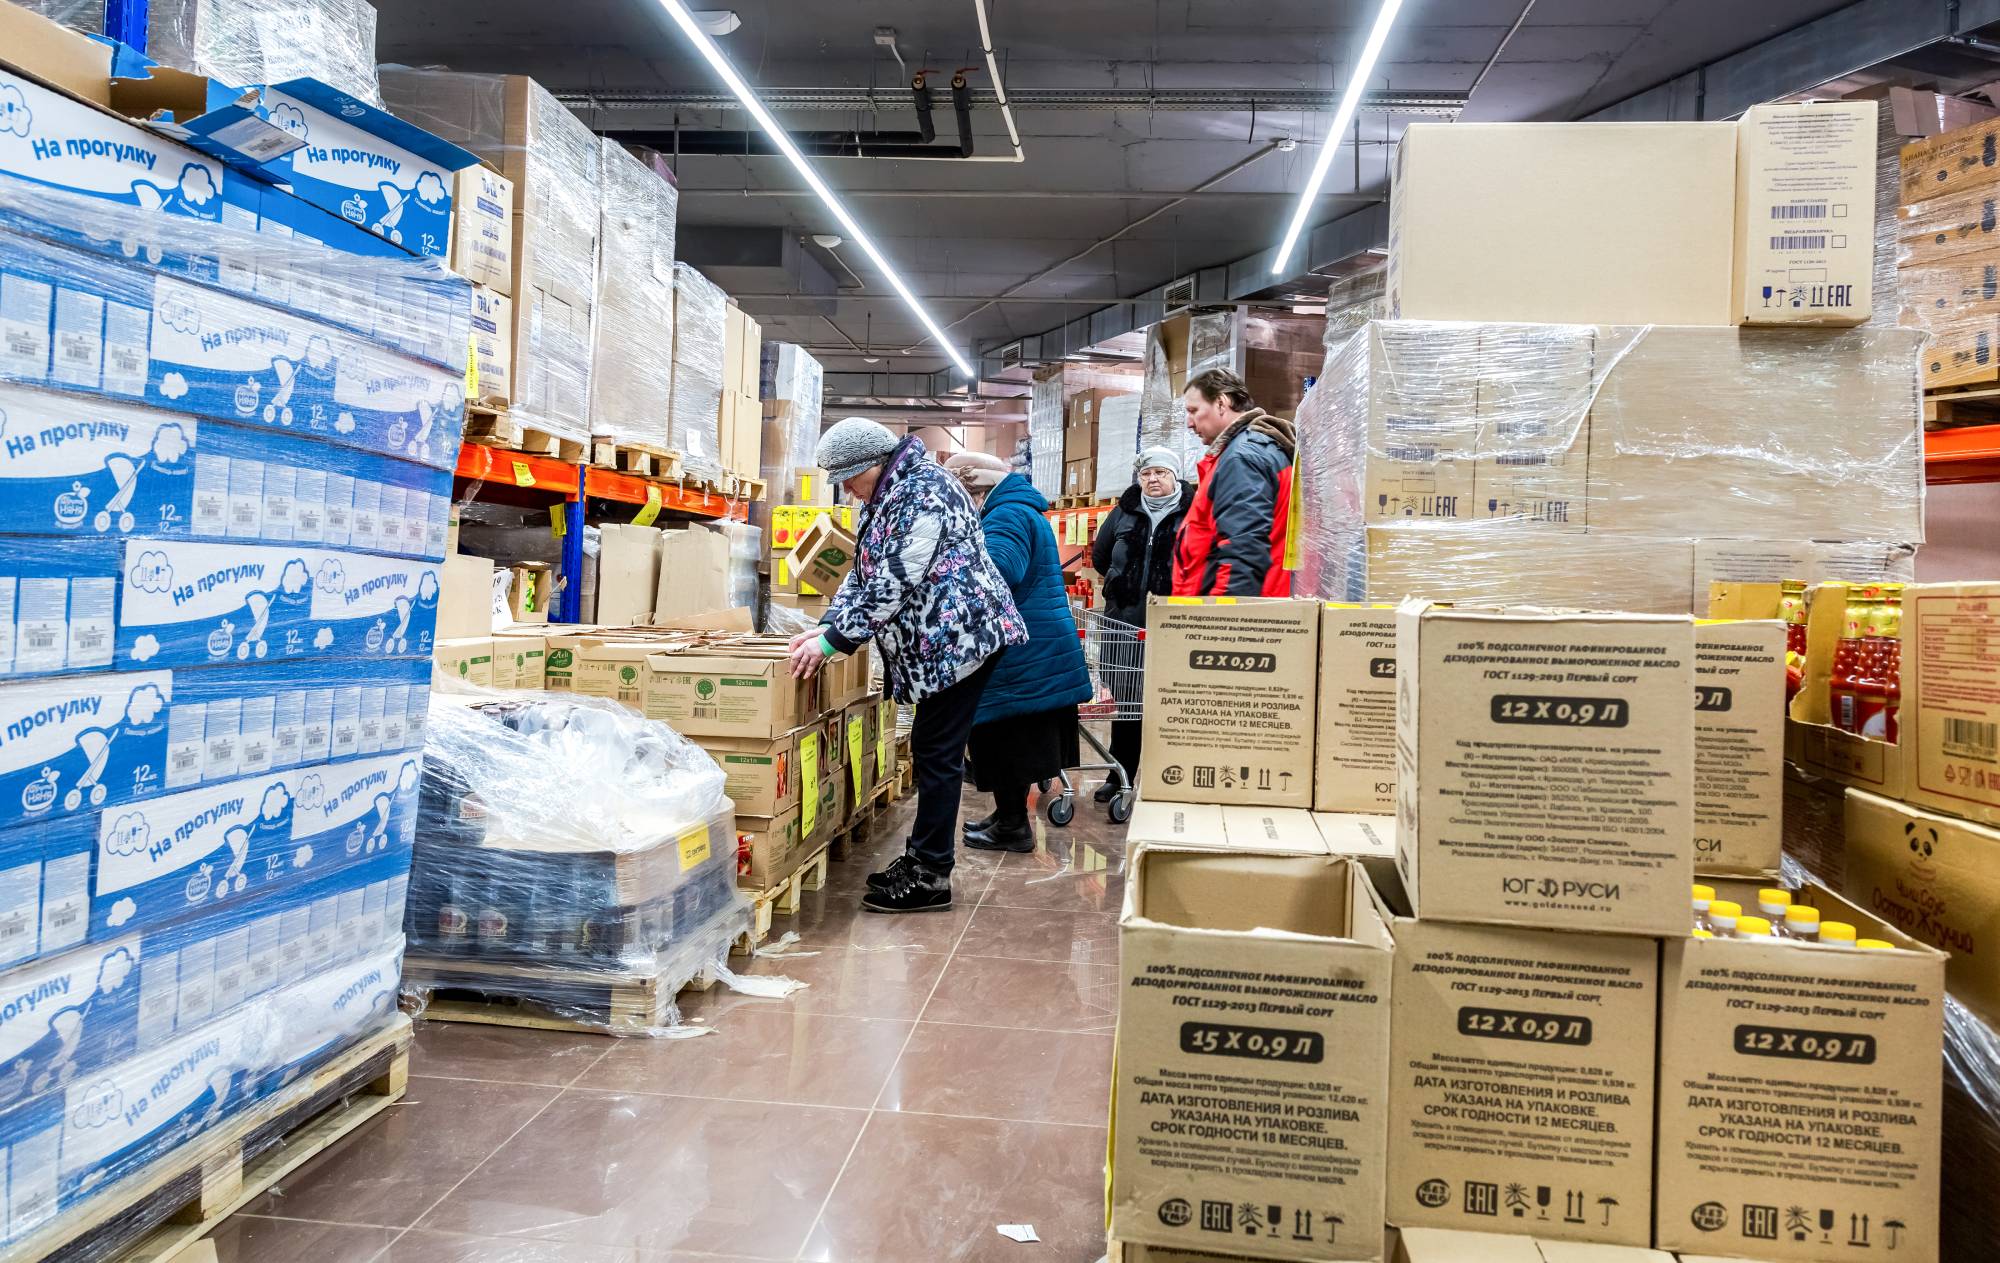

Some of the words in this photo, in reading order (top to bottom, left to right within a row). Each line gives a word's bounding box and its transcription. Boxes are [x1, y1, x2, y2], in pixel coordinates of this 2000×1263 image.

[32, 138, 61, 160] На
[67, 139, 157, 170] прогулку
[307, 147, 328, 164] На
[332, 148, 400, 175] прогулку
[201, 333, 222, 352] На
[225, 327, 291, 347] прогулку
[366, 379, 381, 395] На
[382, 375, 432, 392] прогулку
[6, 436, 36, 459] На
[40, 421, 129, 447] прогулку
[172, 585, 195, 607] На
[198, 564, 265, 593] прогулку
[344, 588, 360, 606] На
[361, 572, 408, 597] прогулку
[1443, 655, 1549, 665] ДЕЗОДОРИРОВАННОЕ
[1551, 657, 1641, 668] ВЫМОРОЖЕННОЕ
[1643, 659, 1680, 668] МАСЛО
[1457, 641, 1484, 651] 100%
[1487, 643, 1567, 653] ПОДСОЛНЕЧНОЕ
[1569, 645, 1667, 655] РАФИНИРОВАННОЕ
[1744, 655, 1774, 663] МАСЛО
[1483, 670, 1510, 680] ГОСТ
[1511, 672, 1563, 683] 1129-2013
[1566, 672, 1609, 683] ПЕРВЫЙ
[1612, 675, 1638, 683] СОРТ
[7, 696, 102, 740] прогулку
[1167, 716, 1190, 724] СРОК
[1192, 718, 1236, 727] ГОДНОСТИ
[1238, 720, 1247, 728] 12
[1250, 720, 1293, 730] МЕСЯЦЕВ.
[1180, 707, 1218, 717] УКАЗАНА
[1220, 709, 1231, 717] НА
[1234, 710, 1280, 720] УПАКОВКЕ.
[1501, 702, 1527, 717] 12
[1533, 703, 1552, 719] Х
[1556, 704, 1595, 724] 0,9
[1600, 705, 1619, 720] Л
[323, 800, 339, 817] На
[340, 768, 388, 801] прогулку
[148, 839, 172, 862] На
[175, 797, 244, 841] прогулку
[1503, 877, 1535, 893] ЮГ
[1562, 880, 1620, 900] РУСИ
[1146, 964, 1176, 974] 100%
[1178, 967, 1262, 981] ПОДСОЛНЕЧНОЕ
[1264, 973, 1365, 989] РАФИНИРОВАННОЕ
[1412, 963, 1516, 979] ДЕЗОДОРИРОВАННОЕ
[1518, 972, 1605, 987] ВЫМОРОЖЕННОЕ
[1607, 980, 1643, 990] МАСЛО
[1427, 952, 1454, 961] 100%
[1456, 954, 1534, 968] ПОДСОЛНЕЧНОЕ
[1536, 961, 1631, 976] РАФИНИРОВАННОЕ
[333, 967, 383, 1011] прогулку
[1131, 977, 1242, 994] ДЕЗОДОРИРОВАННОЕ
[1244, 985, 1338, 1001] ВЫМОРОЖЕННОЕ
[1340, 994, 1378, 1004] МАСЛО
[1700, 968, 1729, 978] 100%
[1731, 970, 1815, 984] ПОДСОЛНЕЧНОЕ
[1817, 977, 1917, 992] РАФИНИРОВАННОЕ
[0, 974, 72, 1026] огулку
[1172, 995, 1200, 1007] ГОСТ
[1201, 998, 1256, 1013] 1129-2013
[1258, 1001, 1303, 1015] ПЕРВЫЙ
[1306, 1007, 1334, 1018] СОРТ
[1468, 1013, 1494, 1030] 12
[1500, 1016, 1518, 1033] Х
[1522, 1019, 1559, 1041] 0,9
[1564, 1022, 1582, 1038] Л
[1191, 1030, 1220, 1051] 15
[1224, 1032, 1243, 1049] Х
[1248, 1035, 1288, 1057] 0,9
[1292, 1038, 1312, 1055] Л
[1744, 1033, 1772, 1050] 12
[1779, 1035, 1797, 1052] Х
[1802, 1038, 1841, 1059] 0,9
[1846, 1040, 1866, 1057] Л
[125, 1099, 149, 1128] На
[151, 1036, 220, 1097] прогулку
[1140, 1091, 1175, 1106] ДАТА
[1177, 1094, 1281, 1115] ИЗГОТОВЛЕНИЯ
[1285, 1106, 1294, 1116] И
[1297, 1106, 1360, 1122] РОЗЛИВА
[1170, 1108, 1229, 1125] УКАЗАНА
[1233, 1114, 1251, 1126] НА
[1255, 1116, 1328, 1134] УПАКОВКЕ.
[1151, 1121, 1185, 1135] СРОК
[1188, 1124, 1258, 1142] ГОДНОСТИ
[1262, 1132, 1276, 1143] 18
[1279, 1133, 1348, 1150] МЕСЯЦЕВ.
